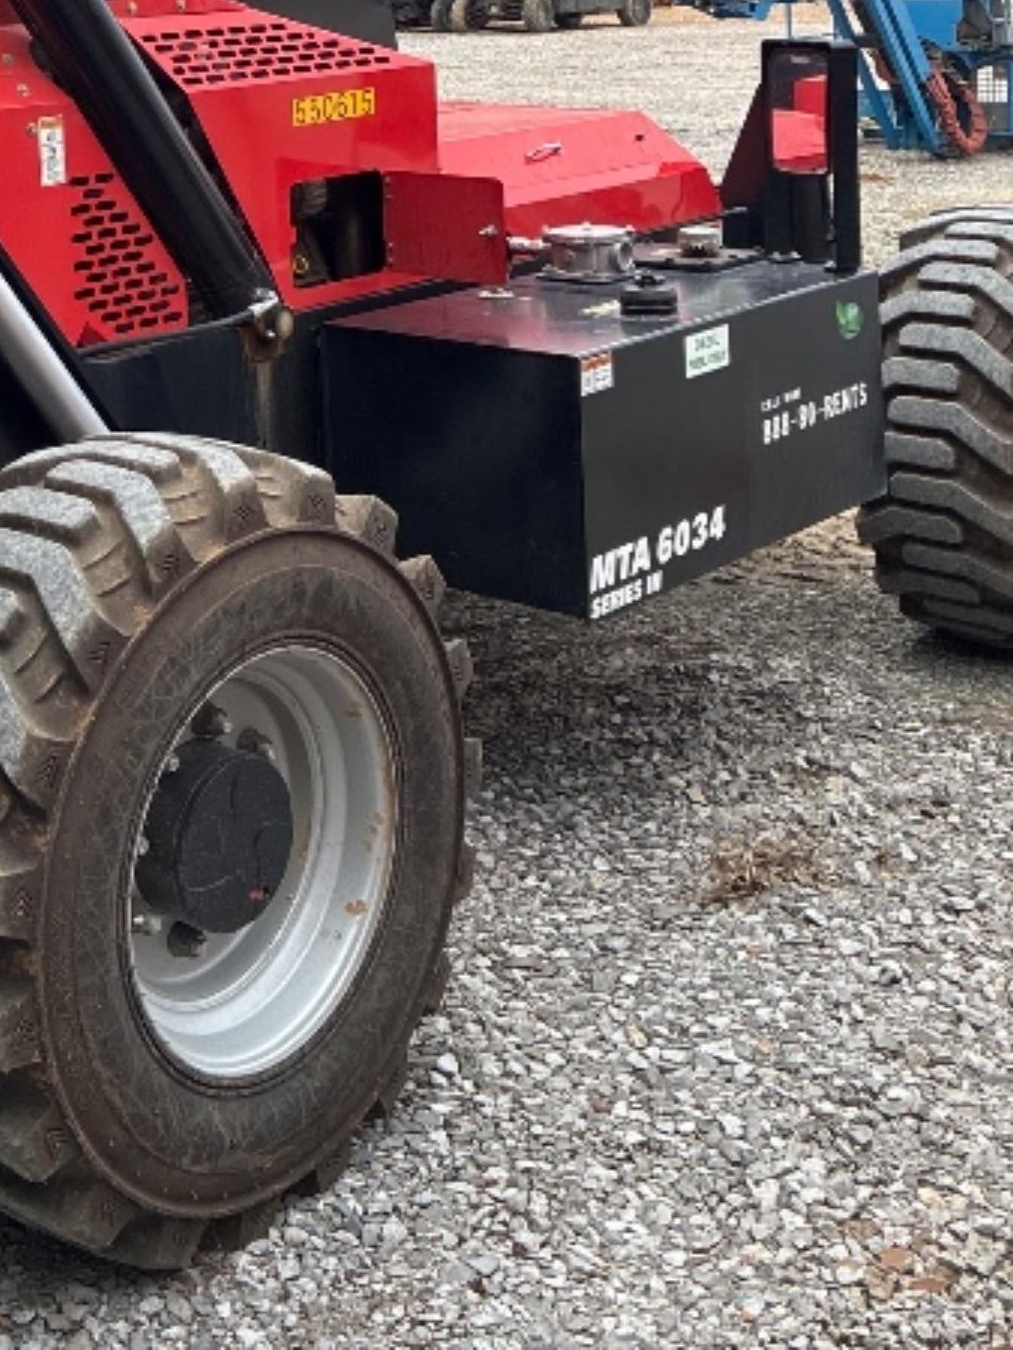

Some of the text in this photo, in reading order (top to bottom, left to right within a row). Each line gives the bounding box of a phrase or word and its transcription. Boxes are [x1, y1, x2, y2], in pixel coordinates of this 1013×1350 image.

[590, 504, 726, 594] MTA 6034
[590, 579, 643, 619] SERIES
